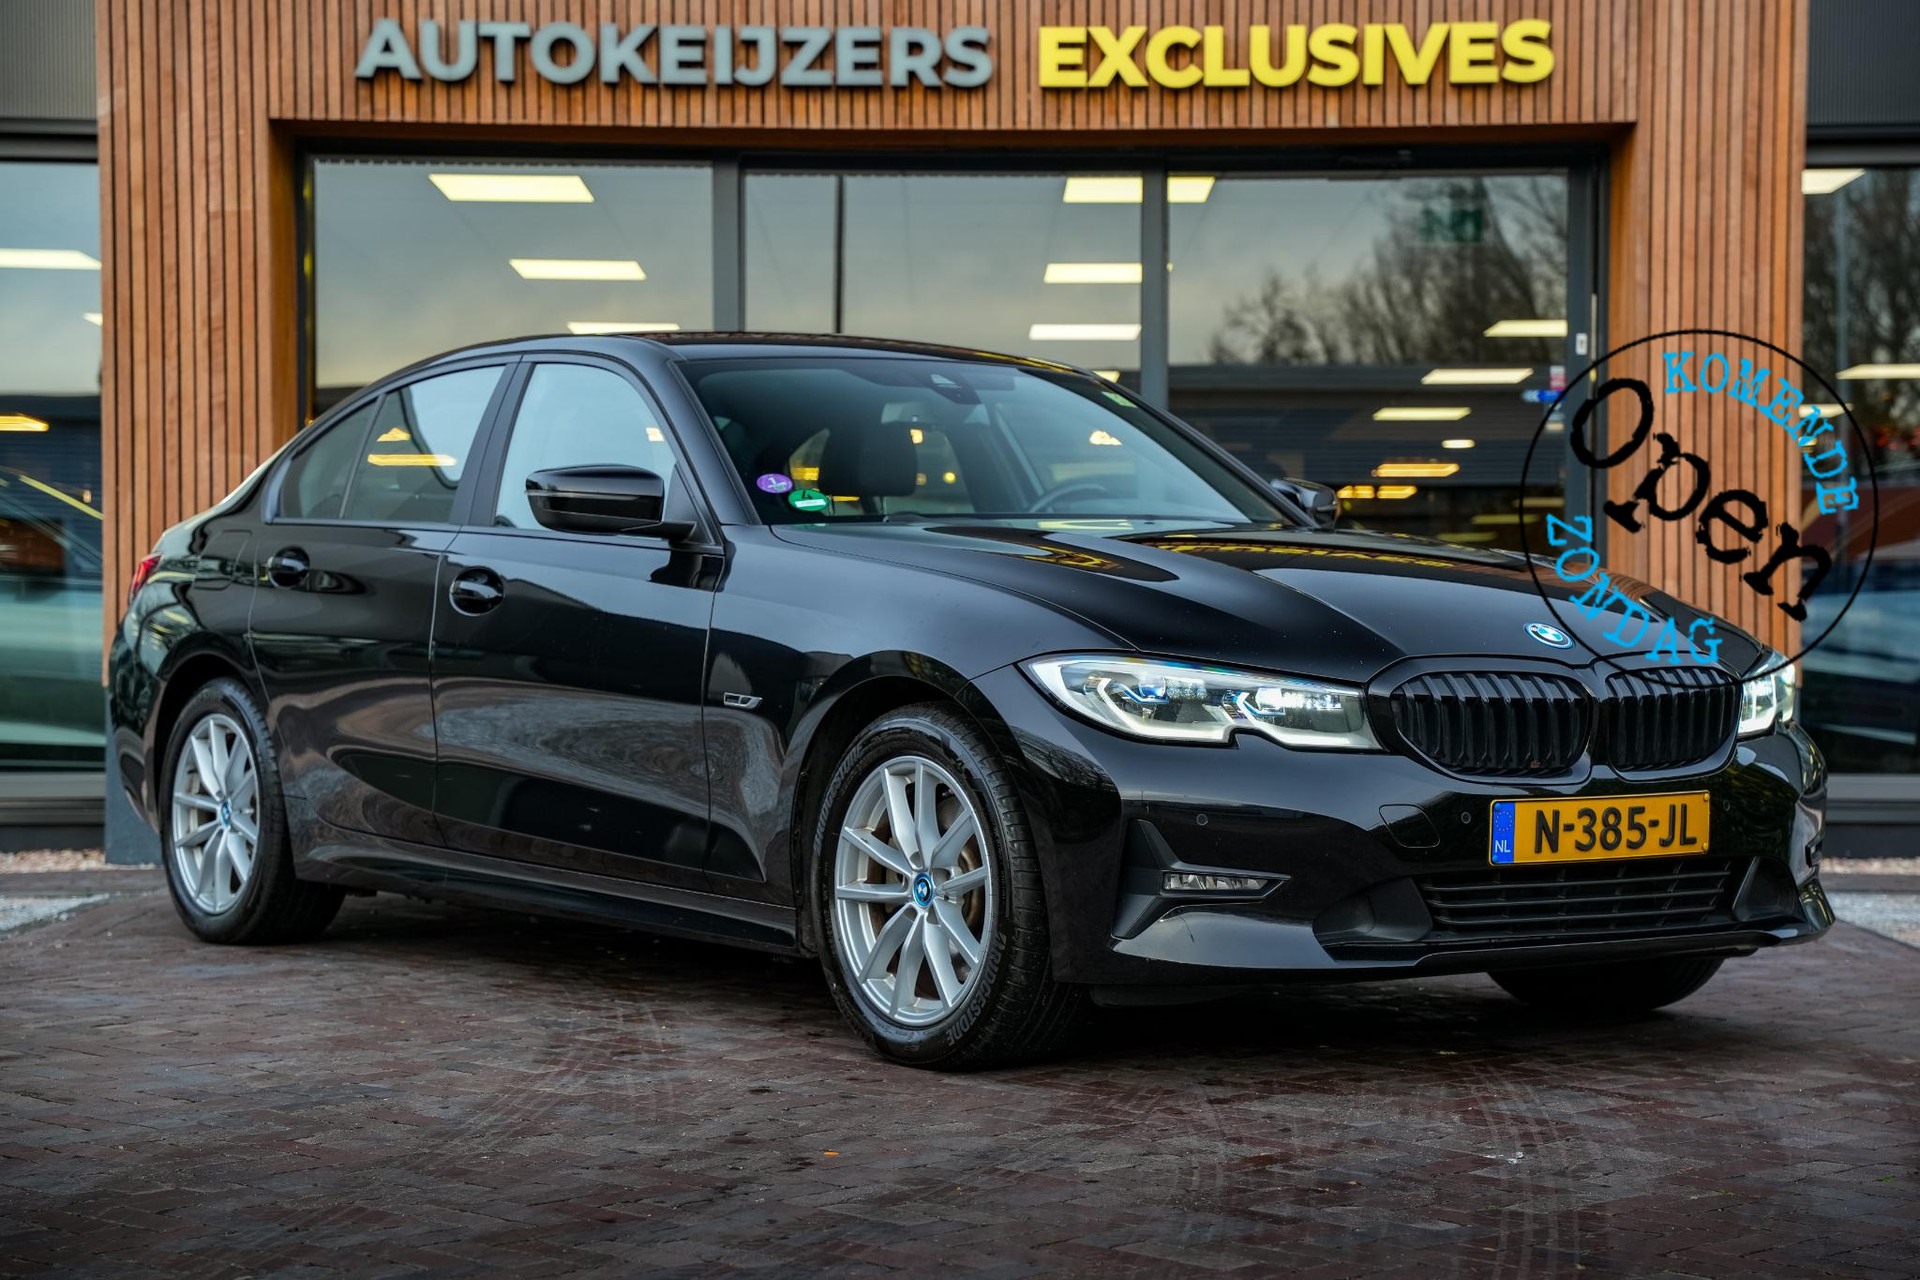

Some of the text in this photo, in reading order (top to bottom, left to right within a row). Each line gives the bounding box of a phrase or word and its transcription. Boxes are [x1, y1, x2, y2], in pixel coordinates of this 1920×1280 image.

[354, 18, 1556, 89] AUTOKEIJZERS EXCLUSIVES
[1494, 839, 1511, 853] NL
[1534, 803, 1697, 854] N-385-JL
